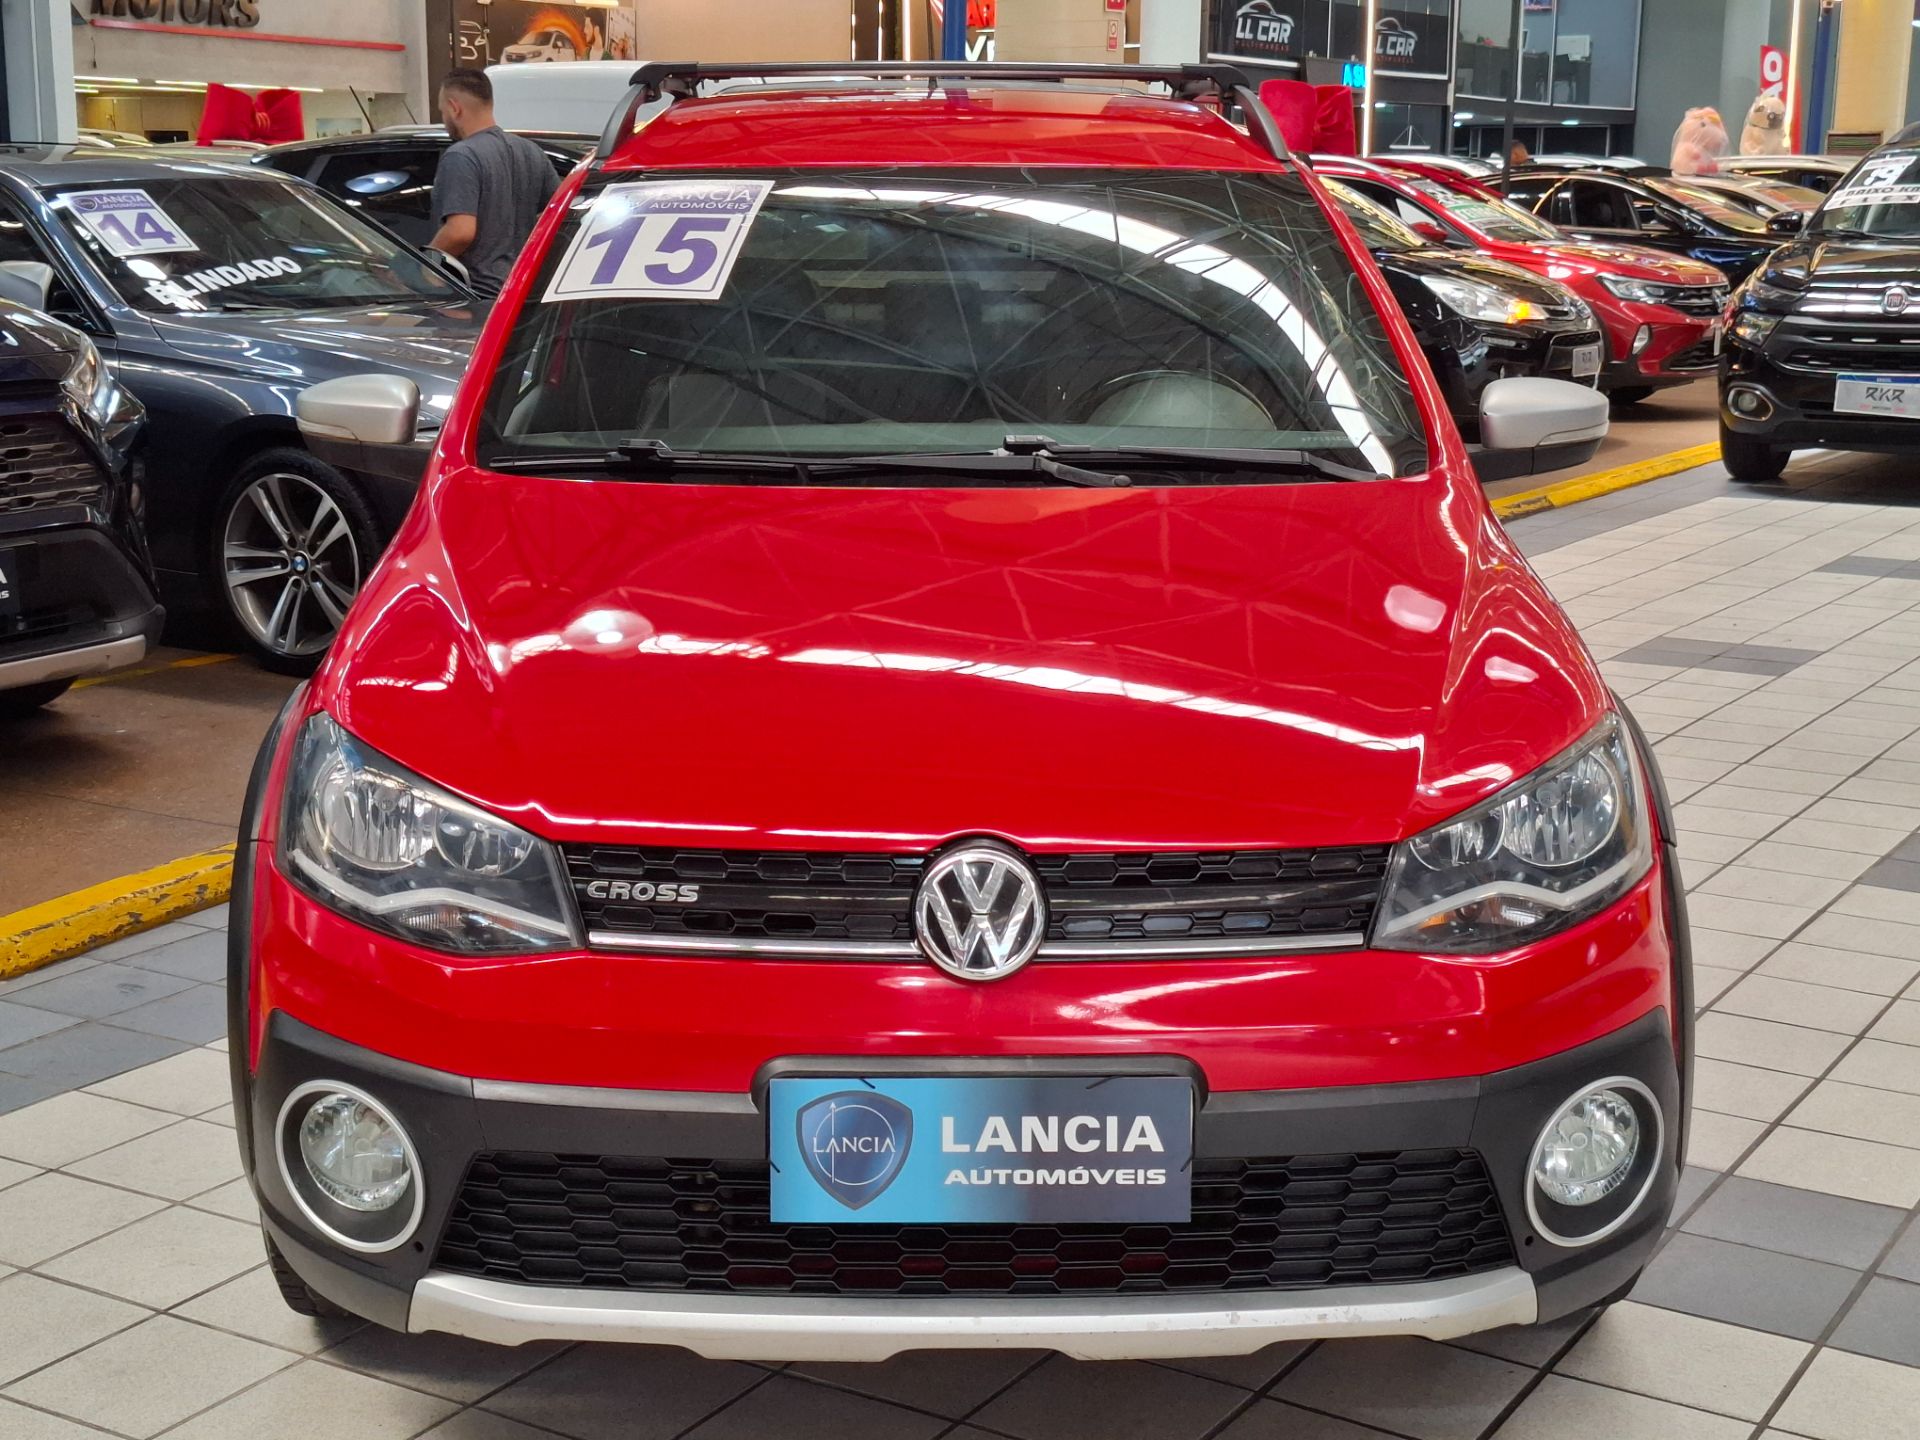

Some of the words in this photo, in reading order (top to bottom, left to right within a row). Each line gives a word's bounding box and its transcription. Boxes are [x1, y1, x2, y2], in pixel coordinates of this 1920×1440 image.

[1235, 17, 1254, 40] LL
[1257, 20, 1292, 44] CAR
[1386, 36, 1415, 57] CAR
[95, 194, 147, 205] LANCIA
[655, 186, 753, 203] ANCIA
[1846, 186, 1895, 197] BAIXO
[649, 200, 750, 210] AUTOMÓVEIS
[97, 212, 177, 247] 14
[585, 217, 731, 286] 15
[144, 256, 302, 306] BLINDADO
[586, 880, 700, 903] CROSS
[812, 1136, 896, 1153] LANCIA
[941, 1115, 1164, 1154] LANCIA
